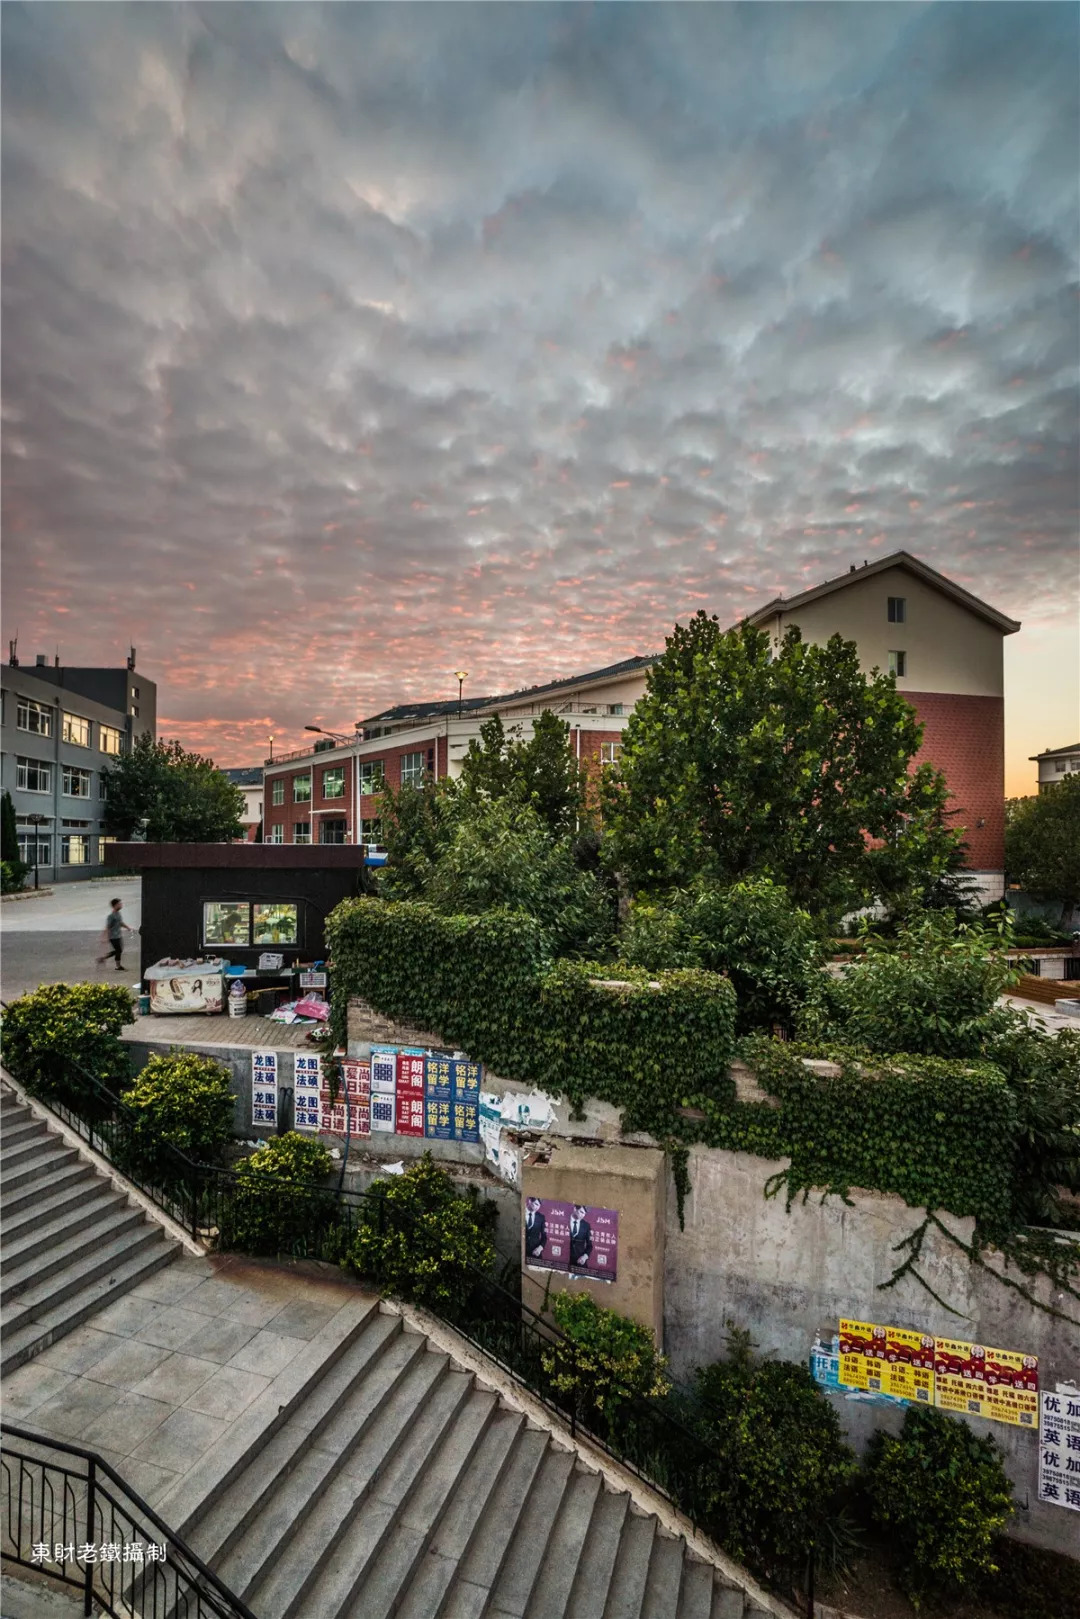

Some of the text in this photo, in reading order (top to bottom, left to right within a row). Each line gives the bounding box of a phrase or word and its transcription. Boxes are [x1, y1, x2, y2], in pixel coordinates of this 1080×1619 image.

[254, 1055, 275, 1067] 龙图
[296, 1057, 318, 1070] 龙图
[347, 1067, 370, 1081] 爱尚
[411, 1060, 423, 1088] 朗阁
[427, 1062, 449, 1074] 铭洋
[456, 1064, 478, 1077] 铭洋
[254, 1071, 275, 1083] 法硕
[296, 1074, 318, 1087] 法硕
[427, 1074, 449, 1086] 留学
[455, 1077, 478, 1089] 留学
[347, 1080, 370, 1094] 日语
[254, 1092, 275, 1104] 龙图
[296, 1095, 318, 1108] 龙图
[254, 1108, 275, 1120] 法硕
[321, 1103, 344, 1117] 爱尚
[411, 1100, 423, 1128] 朗阁
[427, 1102, 449, 1115] 铭洋
[454, 1105, 476, 1118] 铭洋
[296, 1112, 318, 1125] 法硕
[322, 1116, 344, 1131] 日语
[427, 1114, 449, 1127] 留学
[454, 1117, 476, 1130] 留学
[1044, 1396, 1080, 1416] 优加
[1044, 1428, 1080, 1451] 英语
[1043, 1451, 1080, 1473] 优加
[1042, 1482, 1080, 1506] 英语
